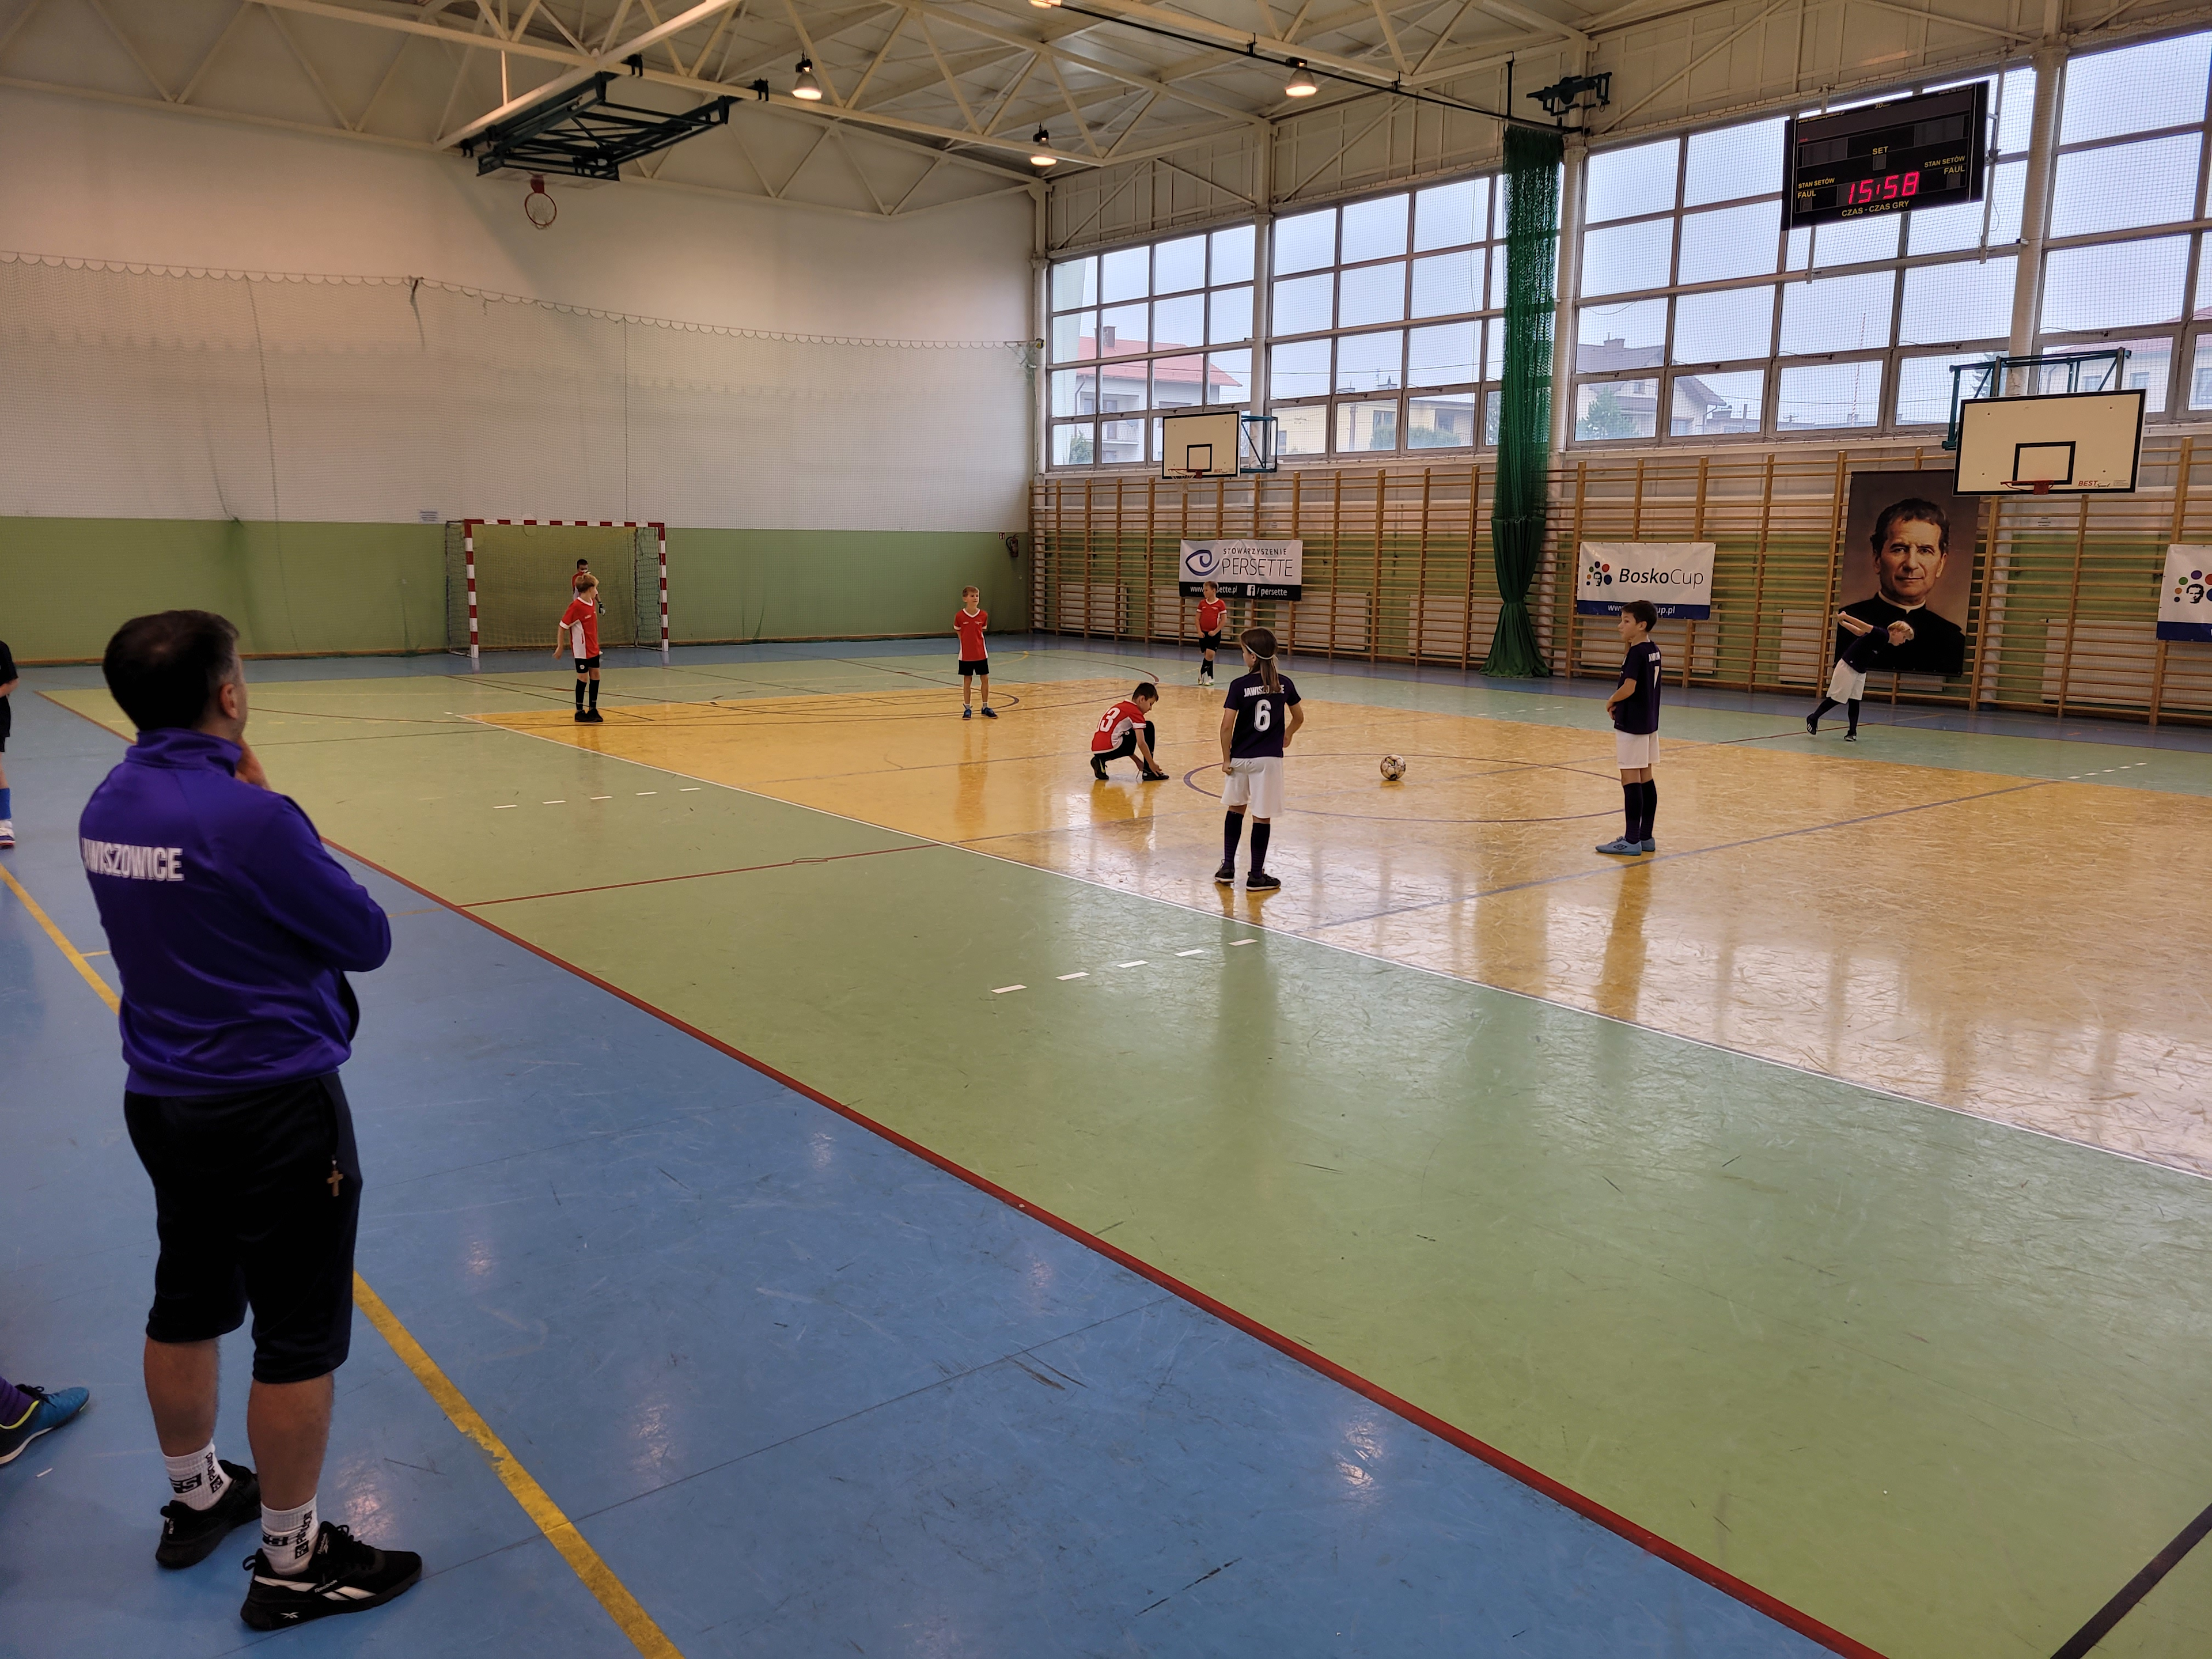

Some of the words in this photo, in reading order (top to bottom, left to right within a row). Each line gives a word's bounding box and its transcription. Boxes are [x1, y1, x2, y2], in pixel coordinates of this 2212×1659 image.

[1872, 146, 1888, 155] SET
[1942, 156, 1965, 165] SETÓW
[1944, 166, 1965, 175] FAUL
[1813, 177, 1835, 187] SETÓW
[1797, 190, 1816, 199] FAUL
[1842, 208, 1863, 217] CZAS
[1869, 203, 1891, 213] CZAS
[1892, 200, 1910, 210] GRY
[1222, 558, 1293, 577] PERSETTE
[1619, 569, 1703, 589] BoskoCup
[1190, 585, 1237, 595] wwwsette.pl
[1260, 588, 1287, 596] persette
[1254, 699, 1271, 732] 6
[315, 1580, 338, 1593] Reebok
